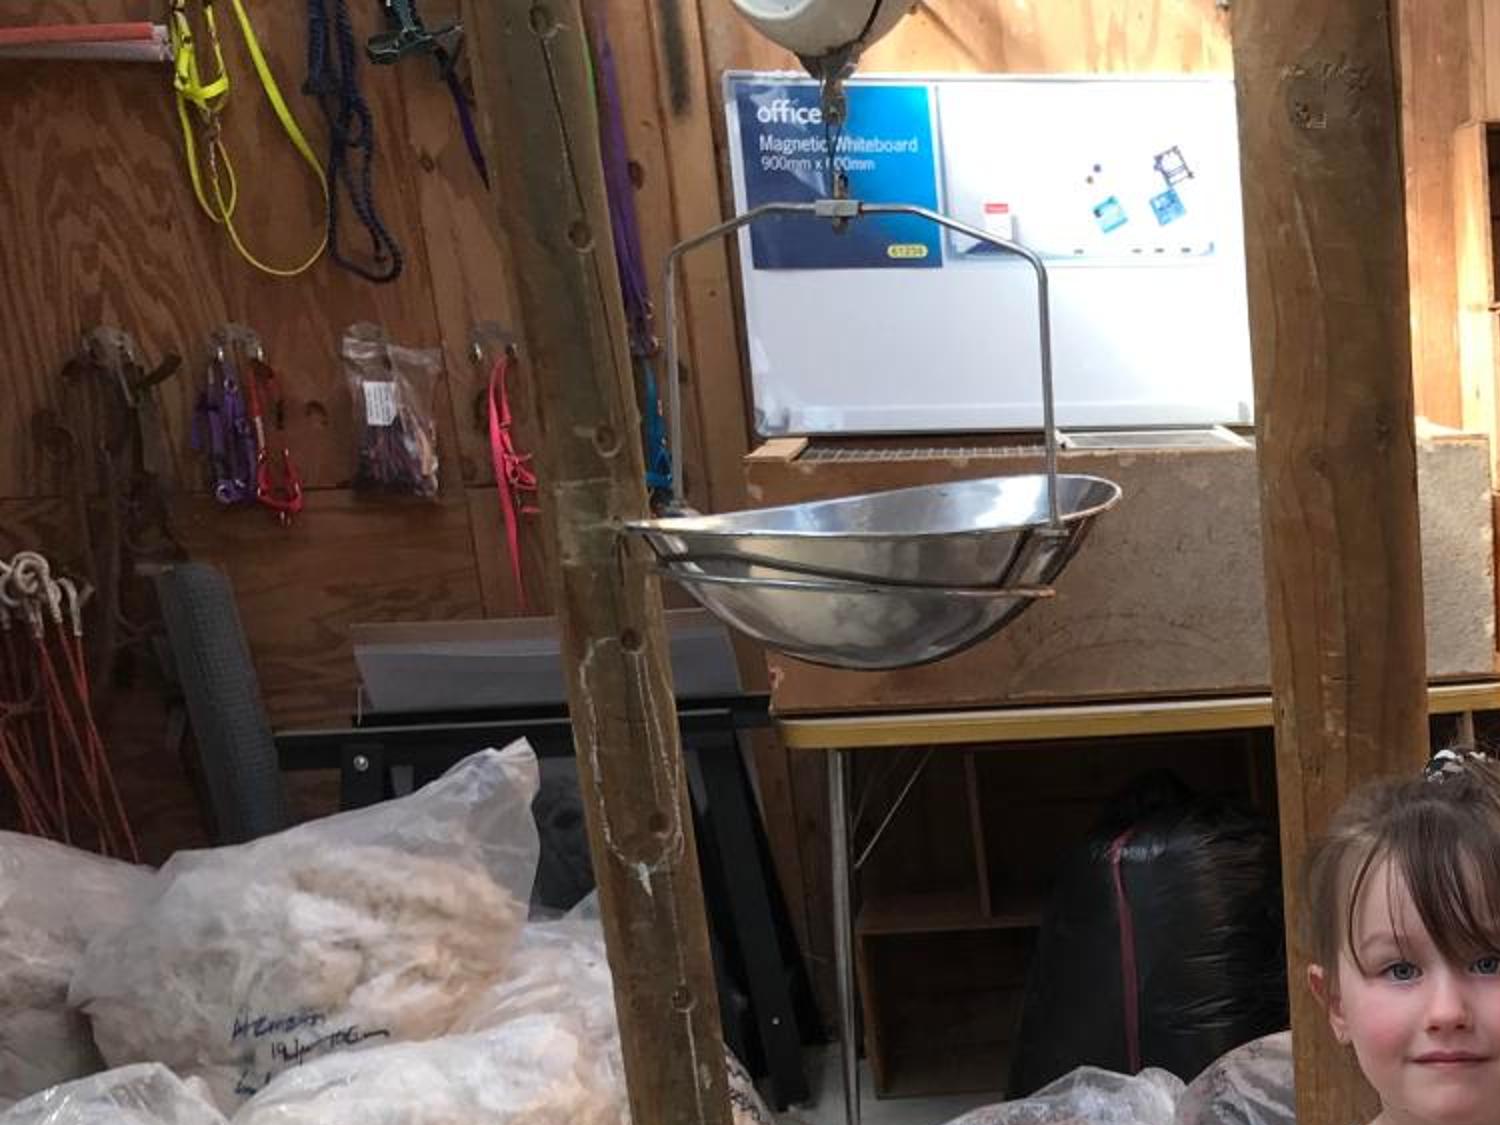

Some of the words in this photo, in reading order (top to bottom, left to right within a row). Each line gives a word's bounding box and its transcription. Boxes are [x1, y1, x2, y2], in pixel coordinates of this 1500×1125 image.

[757, 100, 823, 124] office
[759, 135, 829, 154] Magnetic
[832, 136, 918, 153] Whiteboard
[761, 156, 811, 171] 900mm
[815, 160, 823, 170] x
